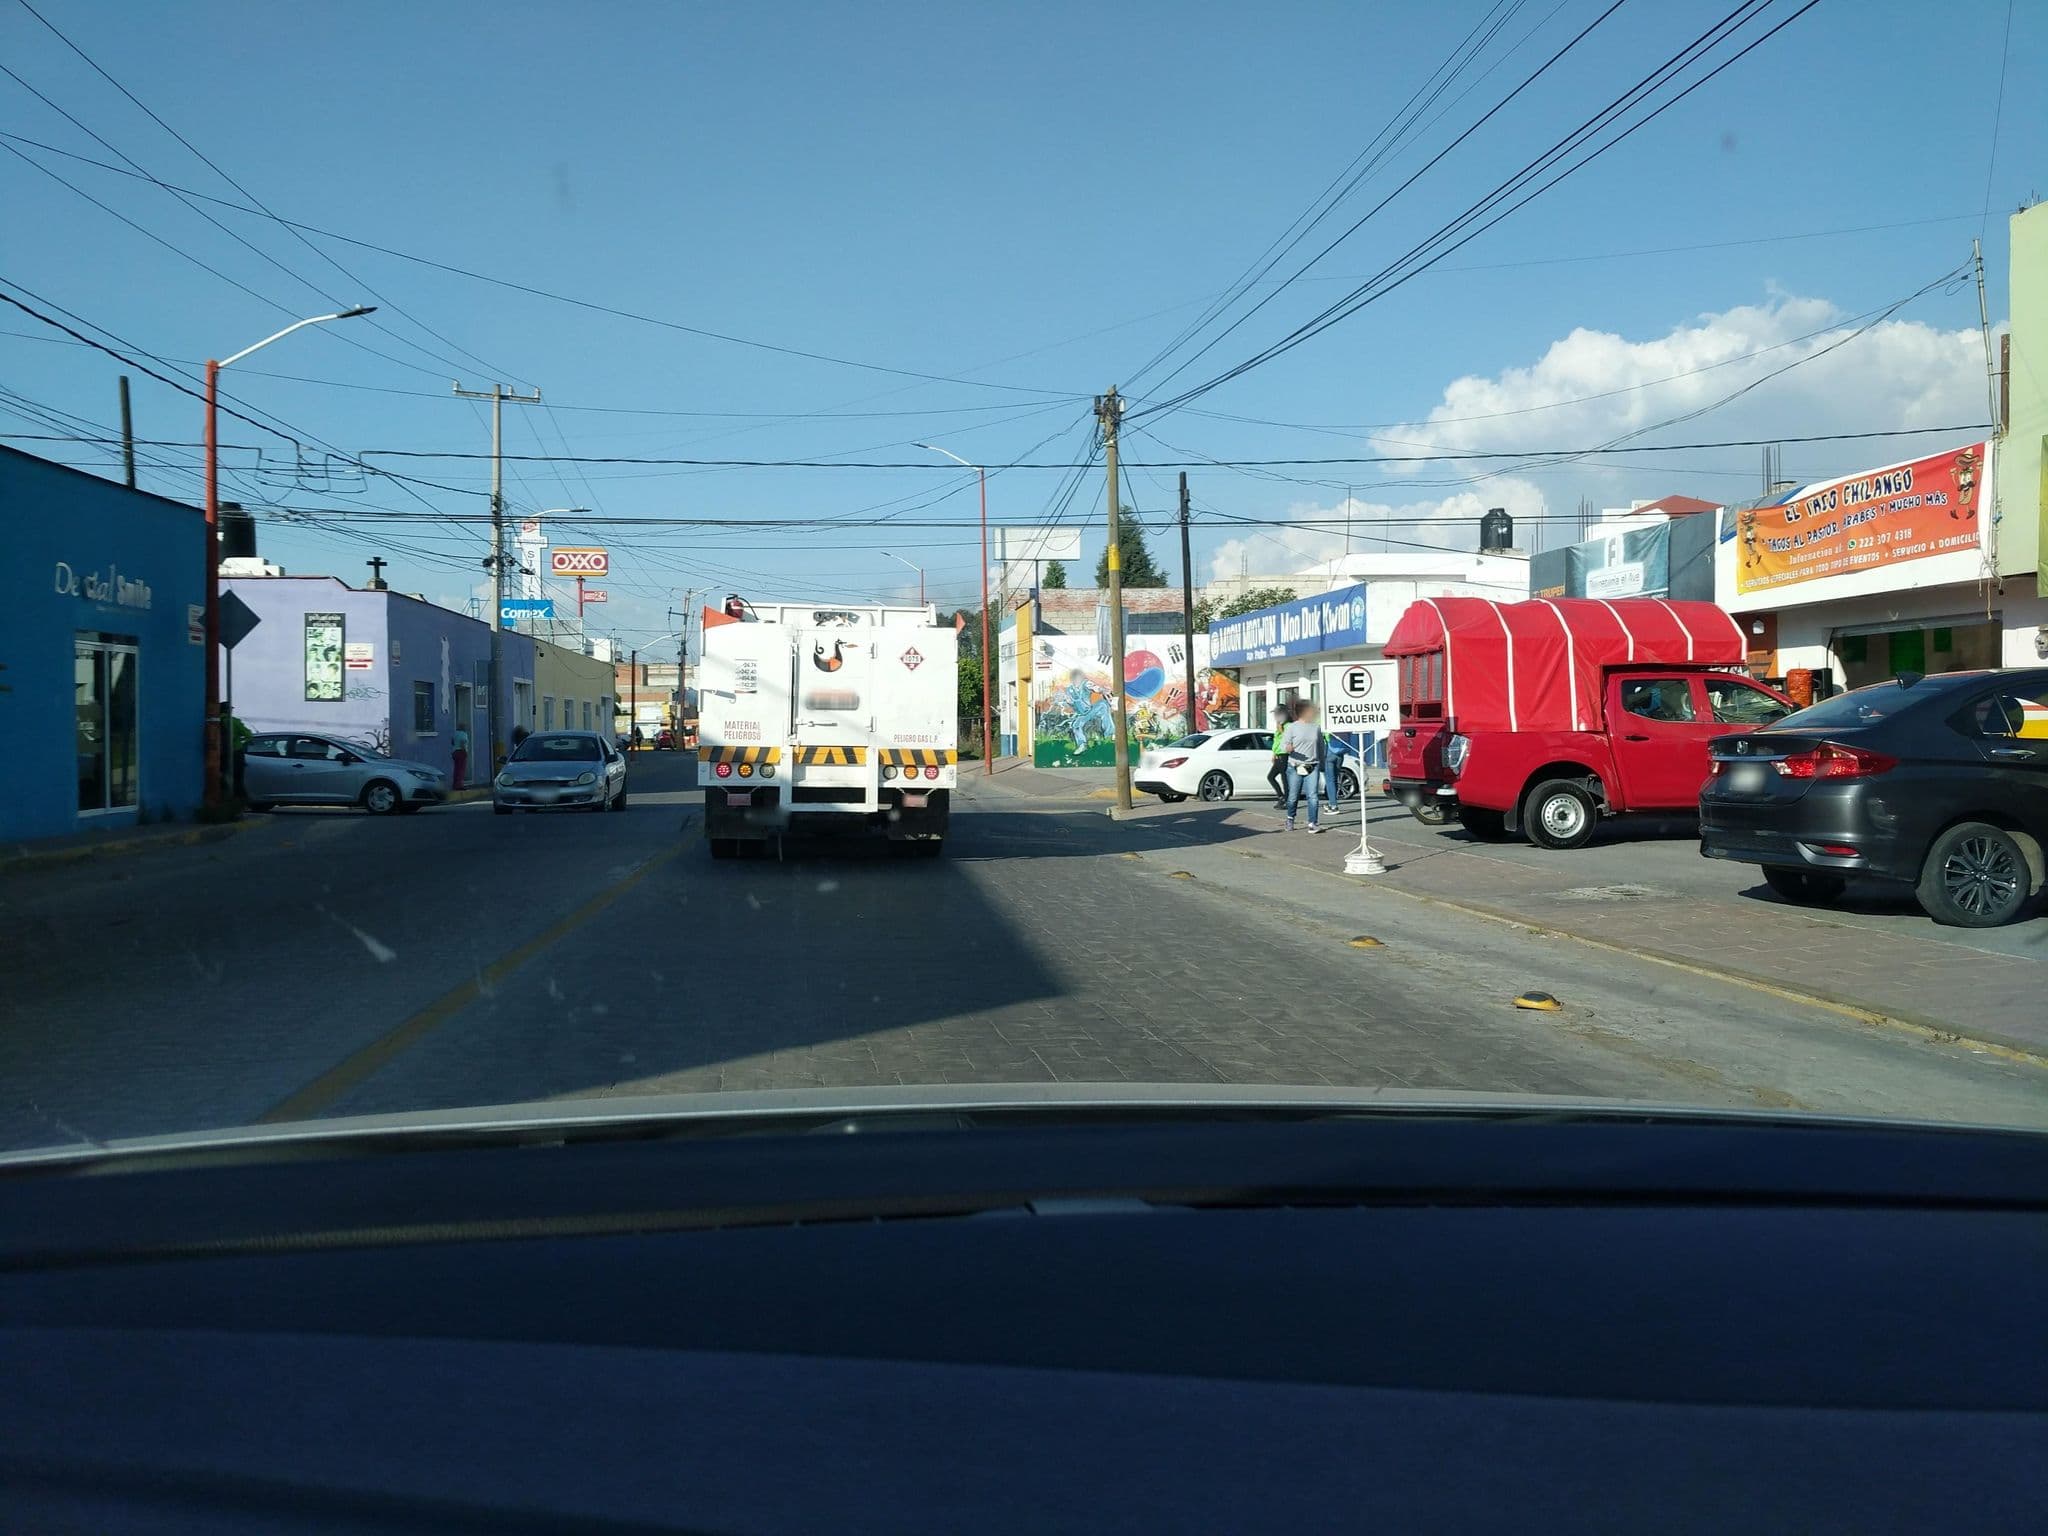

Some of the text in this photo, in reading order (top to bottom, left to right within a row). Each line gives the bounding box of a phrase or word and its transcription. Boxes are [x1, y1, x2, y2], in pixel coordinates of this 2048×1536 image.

[1784, 504, 1801, 522] EL
[1843, 468, 1913, 506] CHILANGO
[1767, 537, 1791, 552] TACOS
[1793, 532, 1805, 548] AL
[1880, 504, 1887, 516] Y
[1889, 495, 1921, 513] MUCHO
[1859, 536, 1874, 548] 222
[1877, 532, 1891, 544] 307
[1894, 528, 1912, 541] 4318
[1892, 532, 1980, 558] SERVICIO A DOMICILIO
[553, 554, 606, 569] OXXO
[1849, 552, 1880, 565] EVENTOS
[500, 606, 550, 618] Comex
[1280, 612, 1299, 643] Moo
[1301, 605, 1321, 639] Duk
[1322, 602, 1350, 634] Kwan
[1349, 673, 1364, 691] E
[1328, 703, 1389, 714] EXCLUSIVO
[724, 720, 761, 730] MATERIAL
[1332, 714, 1386, 724] TAQUERIA
[724, 731, 761, 740] PELIGROSO
[894, 734, 917, 742] PELIGRO
[917, 734, 929, 743] GAS
